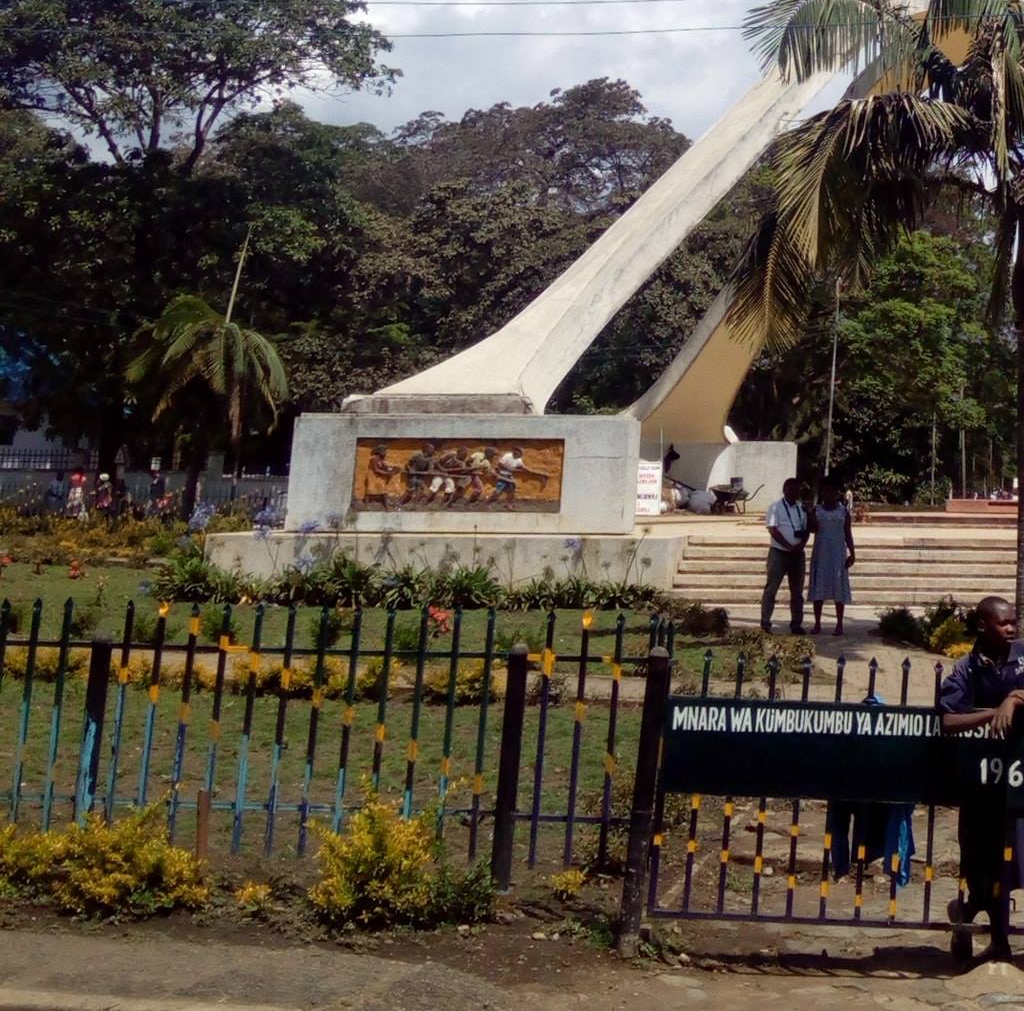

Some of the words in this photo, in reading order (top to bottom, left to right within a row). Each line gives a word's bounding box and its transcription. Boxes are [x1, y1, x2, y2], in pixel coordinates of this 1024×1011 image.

[672, 705, 727, 731] MNARA
[730, 707, 753, 733] WA
[855, 711, 872, 736] YA
[874, 712, 924, 737] AZIMIO
[925, 714, 941, 738] LA
